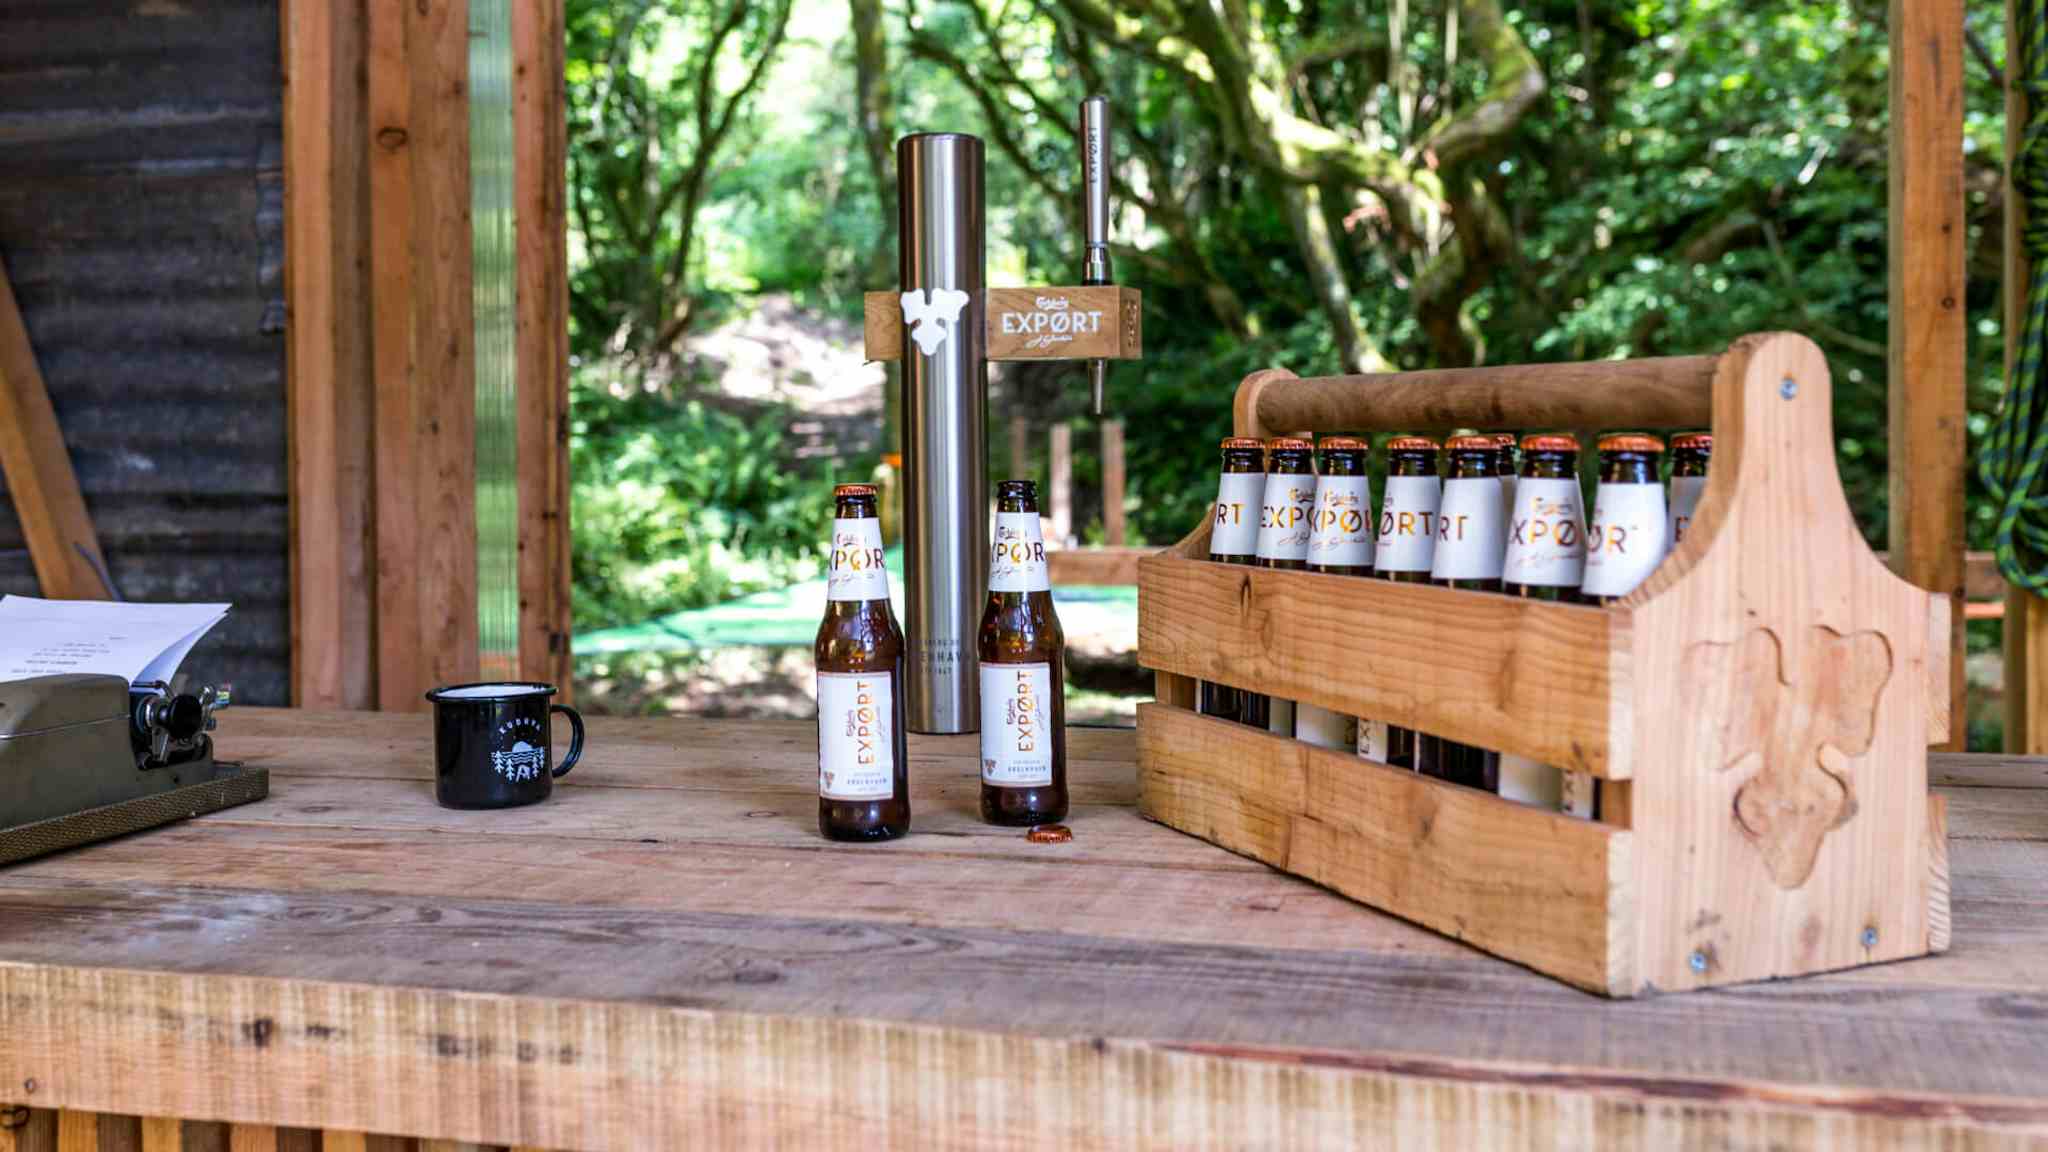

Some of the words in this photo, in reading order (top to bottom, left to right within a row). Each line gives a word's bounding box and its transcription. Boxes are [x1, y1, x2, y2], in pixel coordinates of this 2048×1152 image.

[1002, 311, 1102, 334] EXPØRT
[857, 680, 874, 764] EXPØRT
[1017, 670, 1034, 752] EXPØRT
